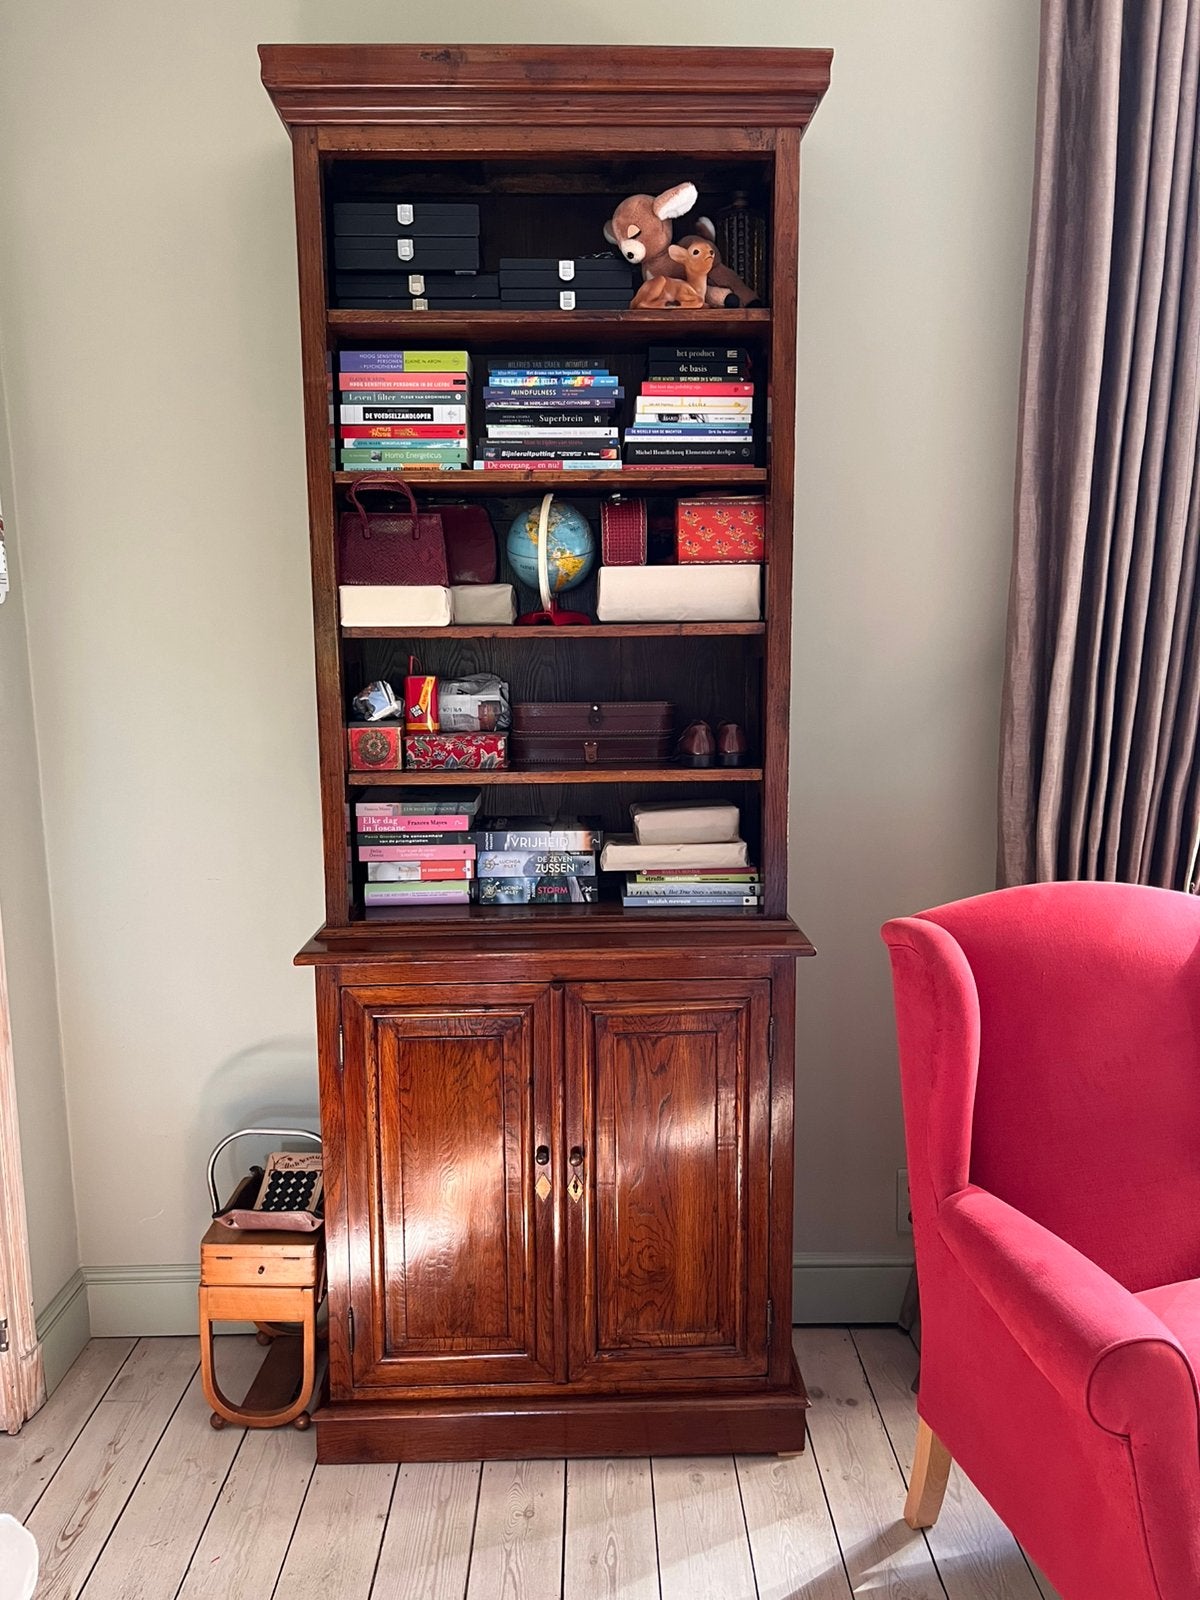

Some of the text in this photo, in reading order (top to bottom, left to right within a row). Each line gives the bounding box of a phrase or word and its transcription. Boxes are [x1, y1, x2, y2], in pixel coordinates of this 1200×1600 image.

[689, 350, 715, 358] product
[539, 415, 583, 424] Superbrein
[488, 462, 498, 470] De
[548, 462, 560, 470] nu?
[383, 817, 398, 825] dag
[511, 837, 568, 848] VRIJHEID
[535, 864, 575, 873] ZUSSEN
